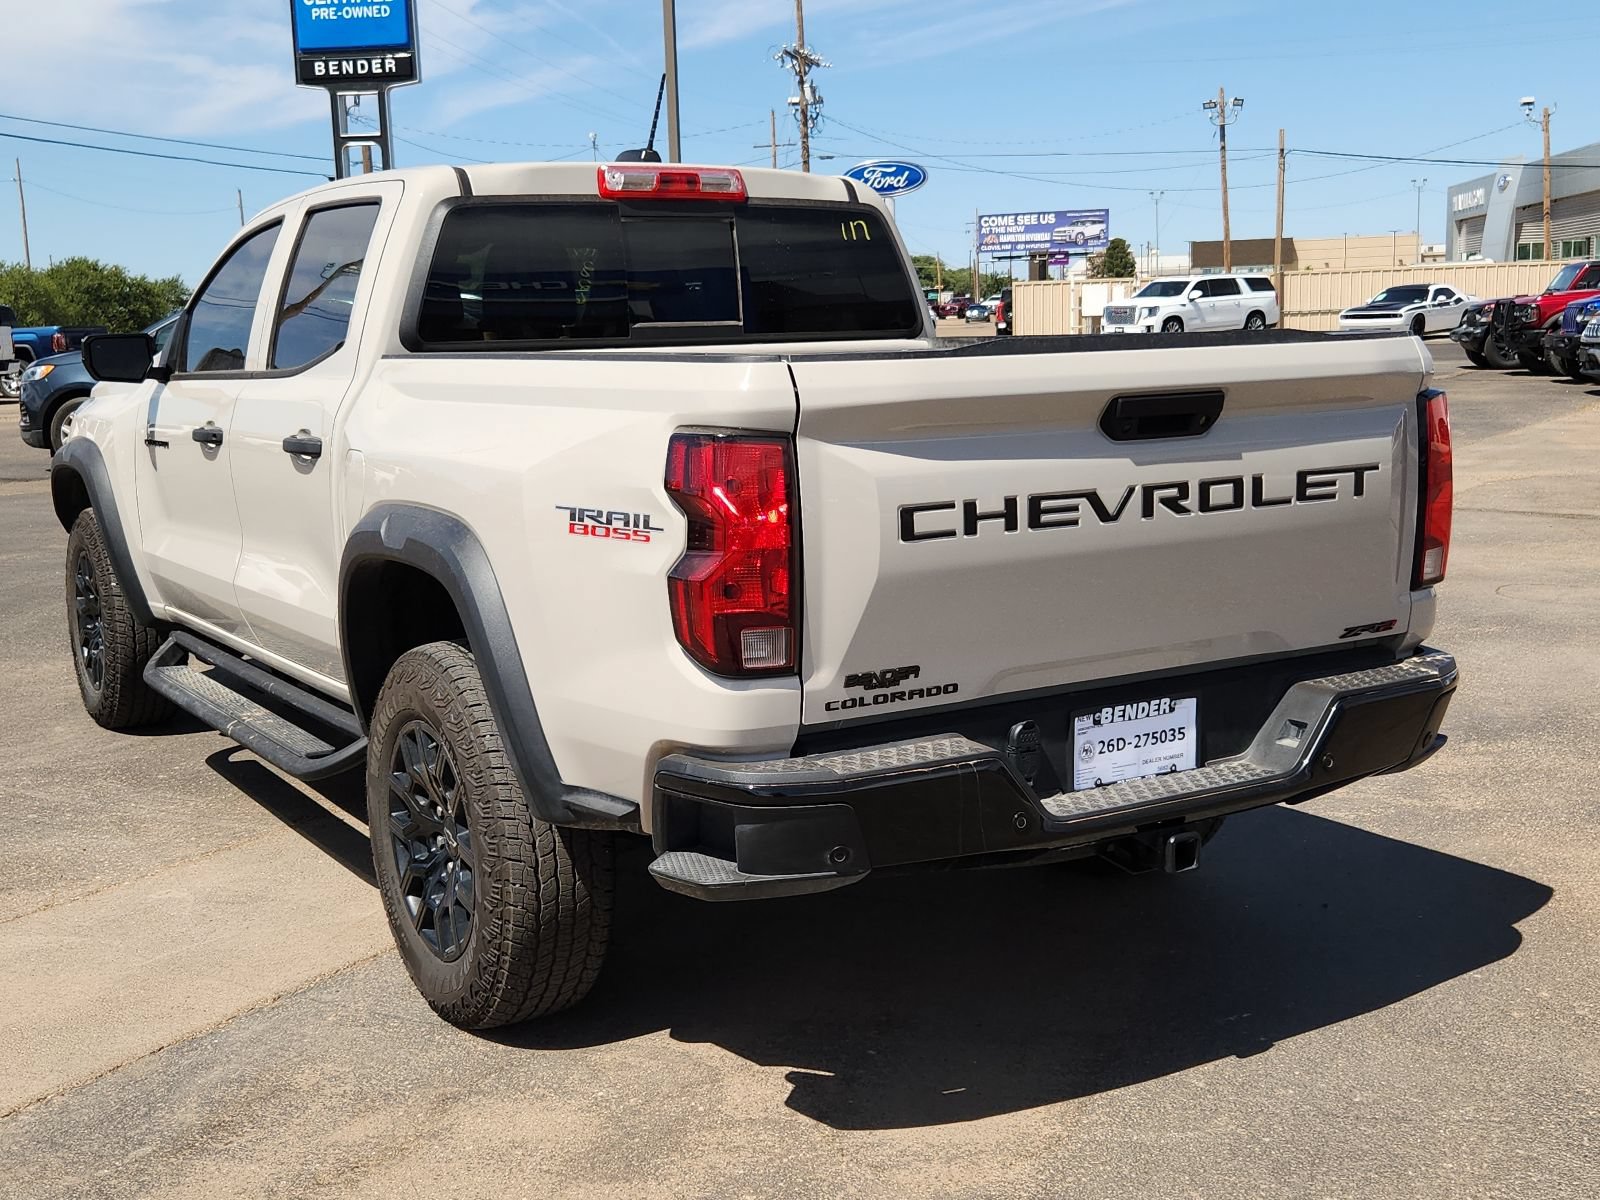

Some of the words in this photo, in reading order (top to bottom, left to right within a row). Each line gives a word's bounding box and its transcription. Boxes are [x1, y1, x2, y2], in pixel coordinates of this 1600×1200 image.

[311, 5, 391, 20] PRE-OWNED
[314, 59, 396, 76] BENDER
[861, 166, 909, 189] Ford
[981, 215, 1016, 227] COME
[1016, 214, 1038, 225] SEE
[1040, 213, 1056, 224] US
[1007, 225, 1025, 233] NEW
[899, 462, 1381, 543] CHEVROLET
[555, 505, 664, 532] TRAIL
[568, 522, 651, 542] BOSS
[824, 682, 959, 712] COLORADO
[1100, 697, 1171, 725] BENDER
[1097, 726, 1187, 755] 26D-275035
[1142, 756, 1162, 765] DEALER
[1163, 752, 1184, 761] NUMBER
